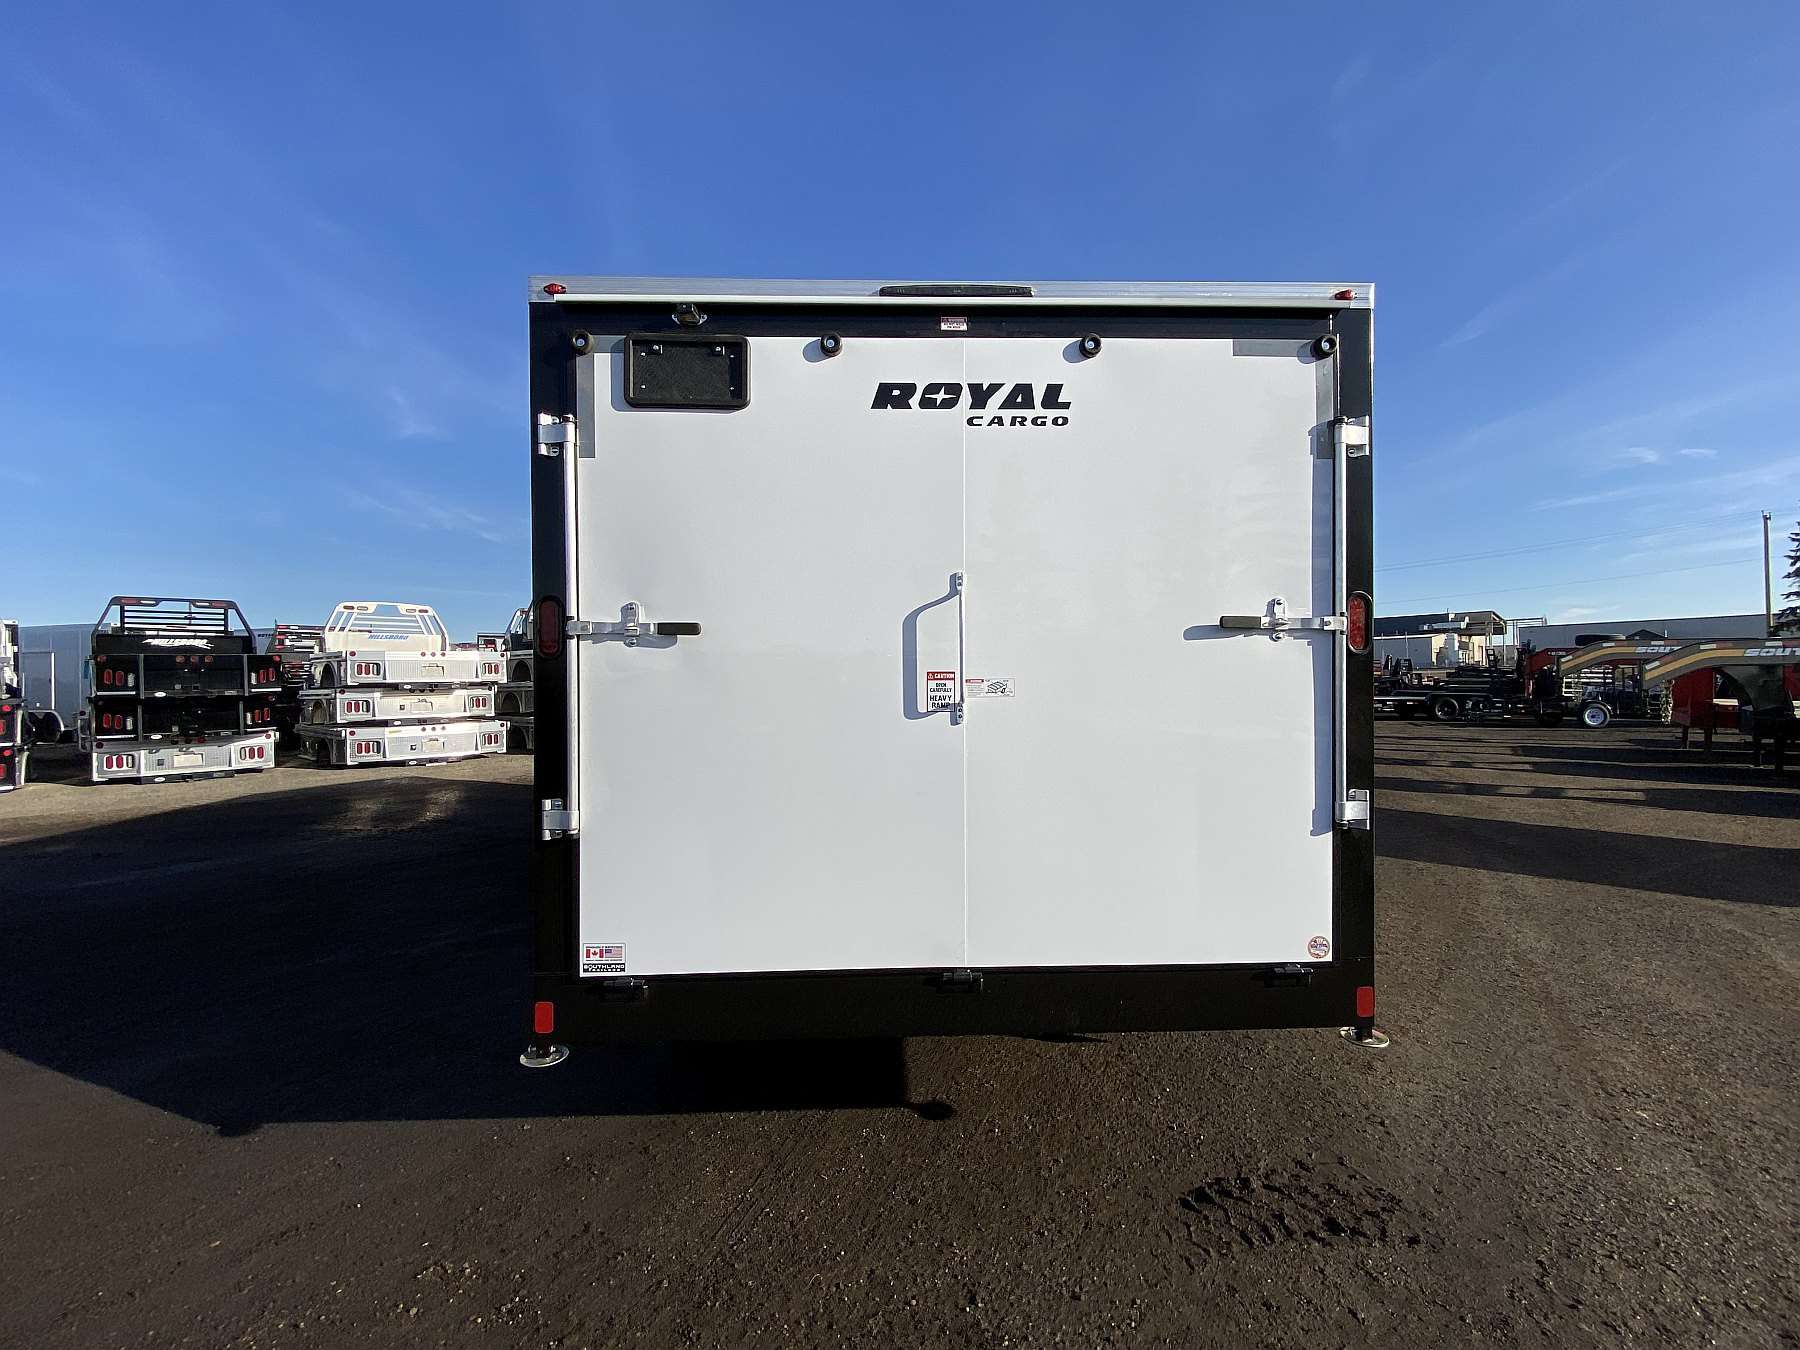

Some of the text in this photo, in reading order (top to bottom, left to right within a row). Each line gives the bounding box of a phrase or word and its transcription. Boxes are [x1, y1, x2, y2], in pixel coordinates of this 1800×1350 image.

[870, 382, 1072, 410] ROYAL
[966, 415, 1070, 427] CARGO
[931, 701, 951, 709] RAMP
